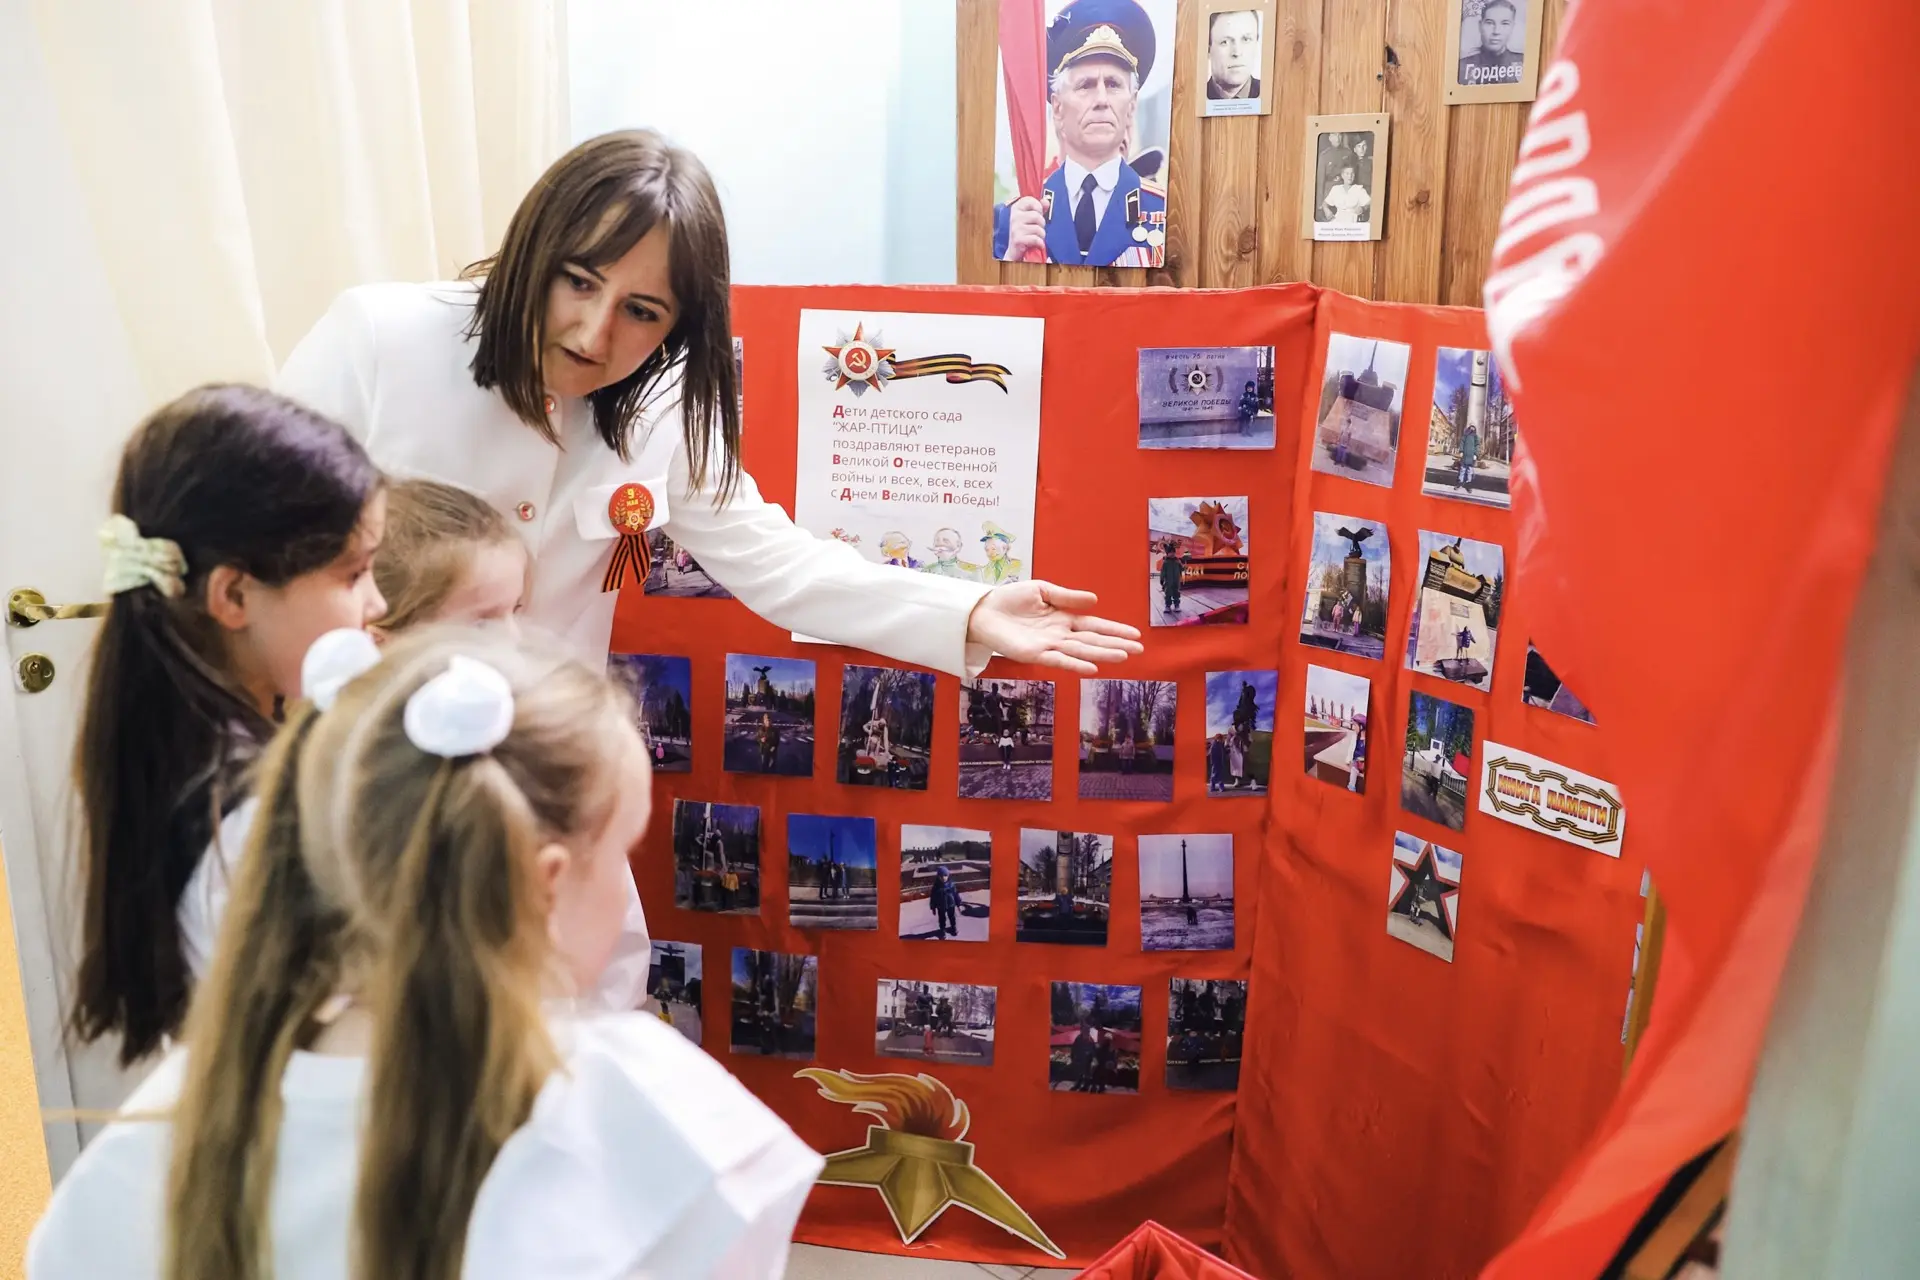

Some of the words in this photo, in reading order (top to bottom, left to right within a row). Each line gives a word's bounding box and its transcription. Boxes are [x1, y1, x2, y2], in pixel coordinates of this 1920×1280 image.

[1465, 63, 1523, 83] Гордеев
[1162, 399, 1199, 408] ВЕЛИКОЙ
[1201, 398, 1232, 406] ПОБЕДЫ
[833, 405, 868, 419] Дети
[870, 408, 930, 420] детского
[932, 411, 963, 424] сада
[833, 439, 921, 453] поздравляют
[924, 444, 997, 458] ветеранов
[832, 454, 889, 468] Великой
[893, 457, 998, 473] Отечественной
[831, 470, 875, 484] войны
[879, 475, 888, 484] и
[891, 475, 923, 488] всех,
[927, 477, 960, 489] всех,
[963, 479, 994, 489] всех
[627, 488, 635, 499] 9
[830, 488, 838, 499] с
[840, 487, 878, 502] Днем
[882, 489, 939, 504] Великой
[943, 492, 1000, 508] Победы!
[1497, 773, 1541, 806] КНИГА
[1546, 788, 1608, 828] ПАМЯТИ
